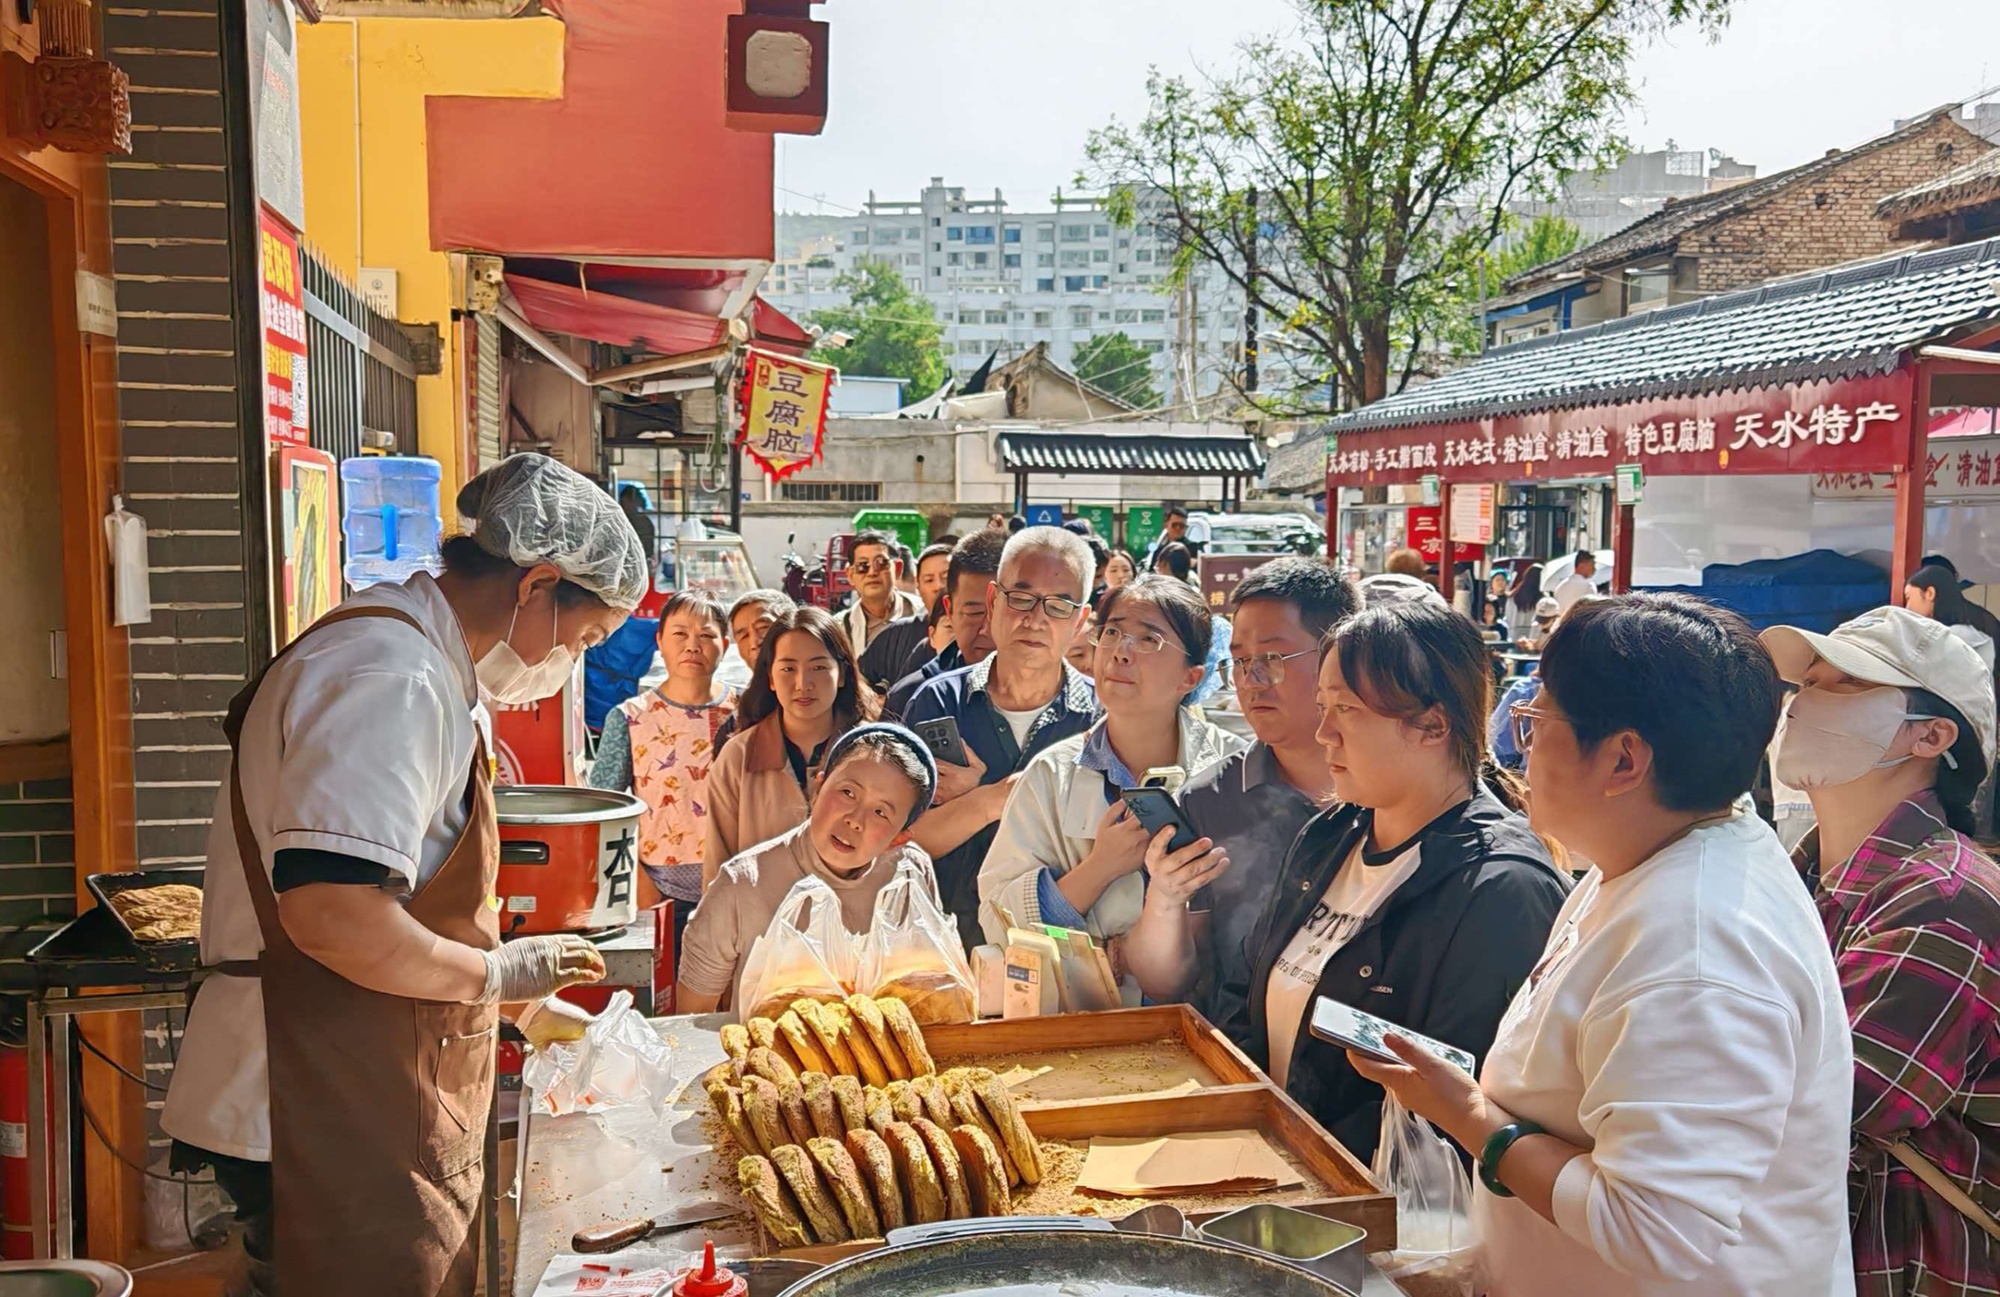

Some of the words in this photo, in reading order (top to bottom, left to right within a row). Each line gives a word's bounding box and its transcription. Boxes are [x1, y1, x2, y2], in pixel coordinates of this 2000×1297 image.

[761, 371, 809, 453] 豆腐脑
[1625, 417, 1715, 456] 特色豆腐脑
[1729, 401, 1900, 450] 天水特产
